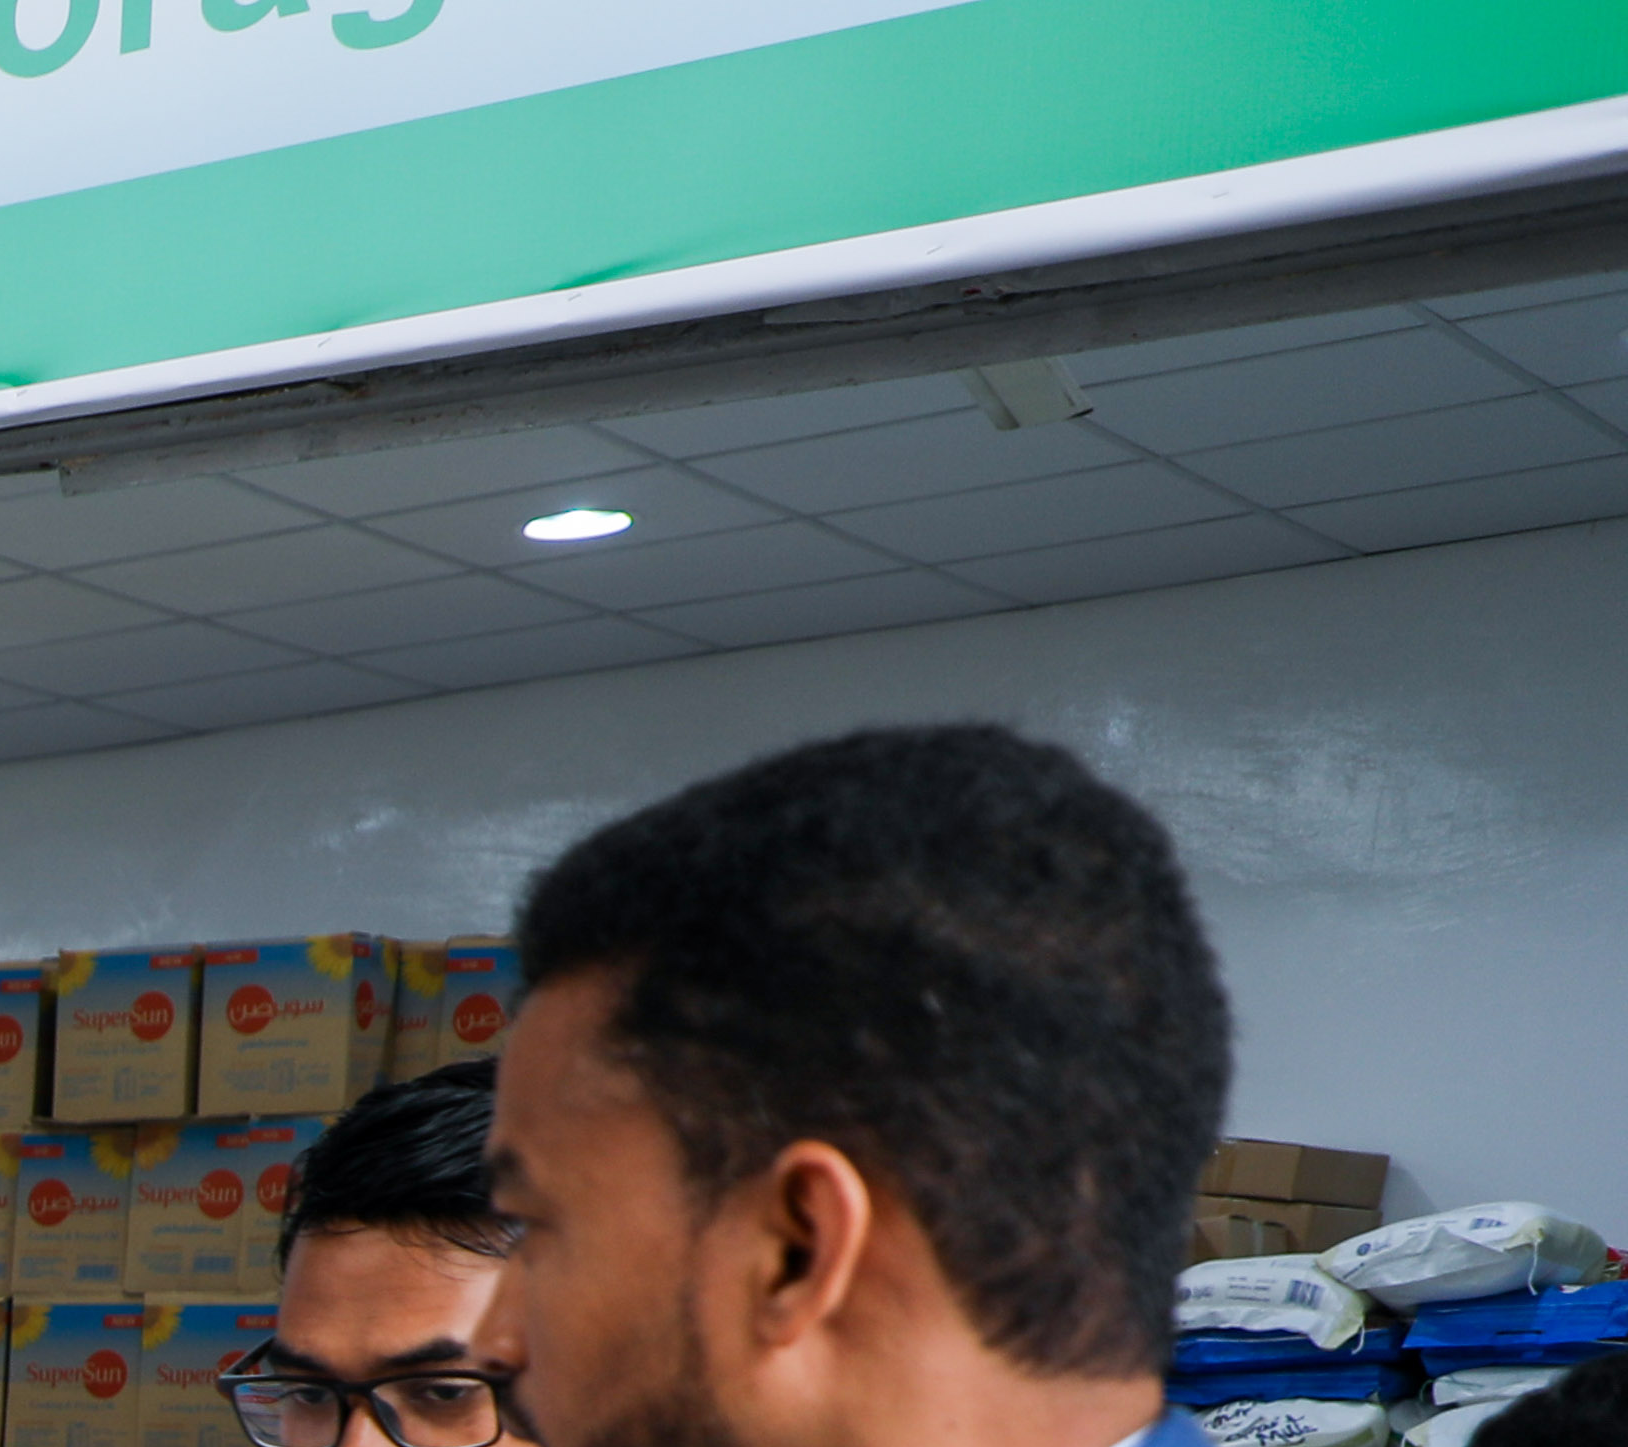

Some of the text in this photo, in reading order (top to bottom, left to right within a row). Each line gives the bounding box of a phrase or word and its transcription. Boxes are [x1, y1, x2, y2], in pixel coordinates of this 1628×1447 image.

[73, 1004, 170, 1034] SuperSun
[137, 1181, 238, 1210] SuperSun
[27, 1361, 123, 1388] SuperSun
